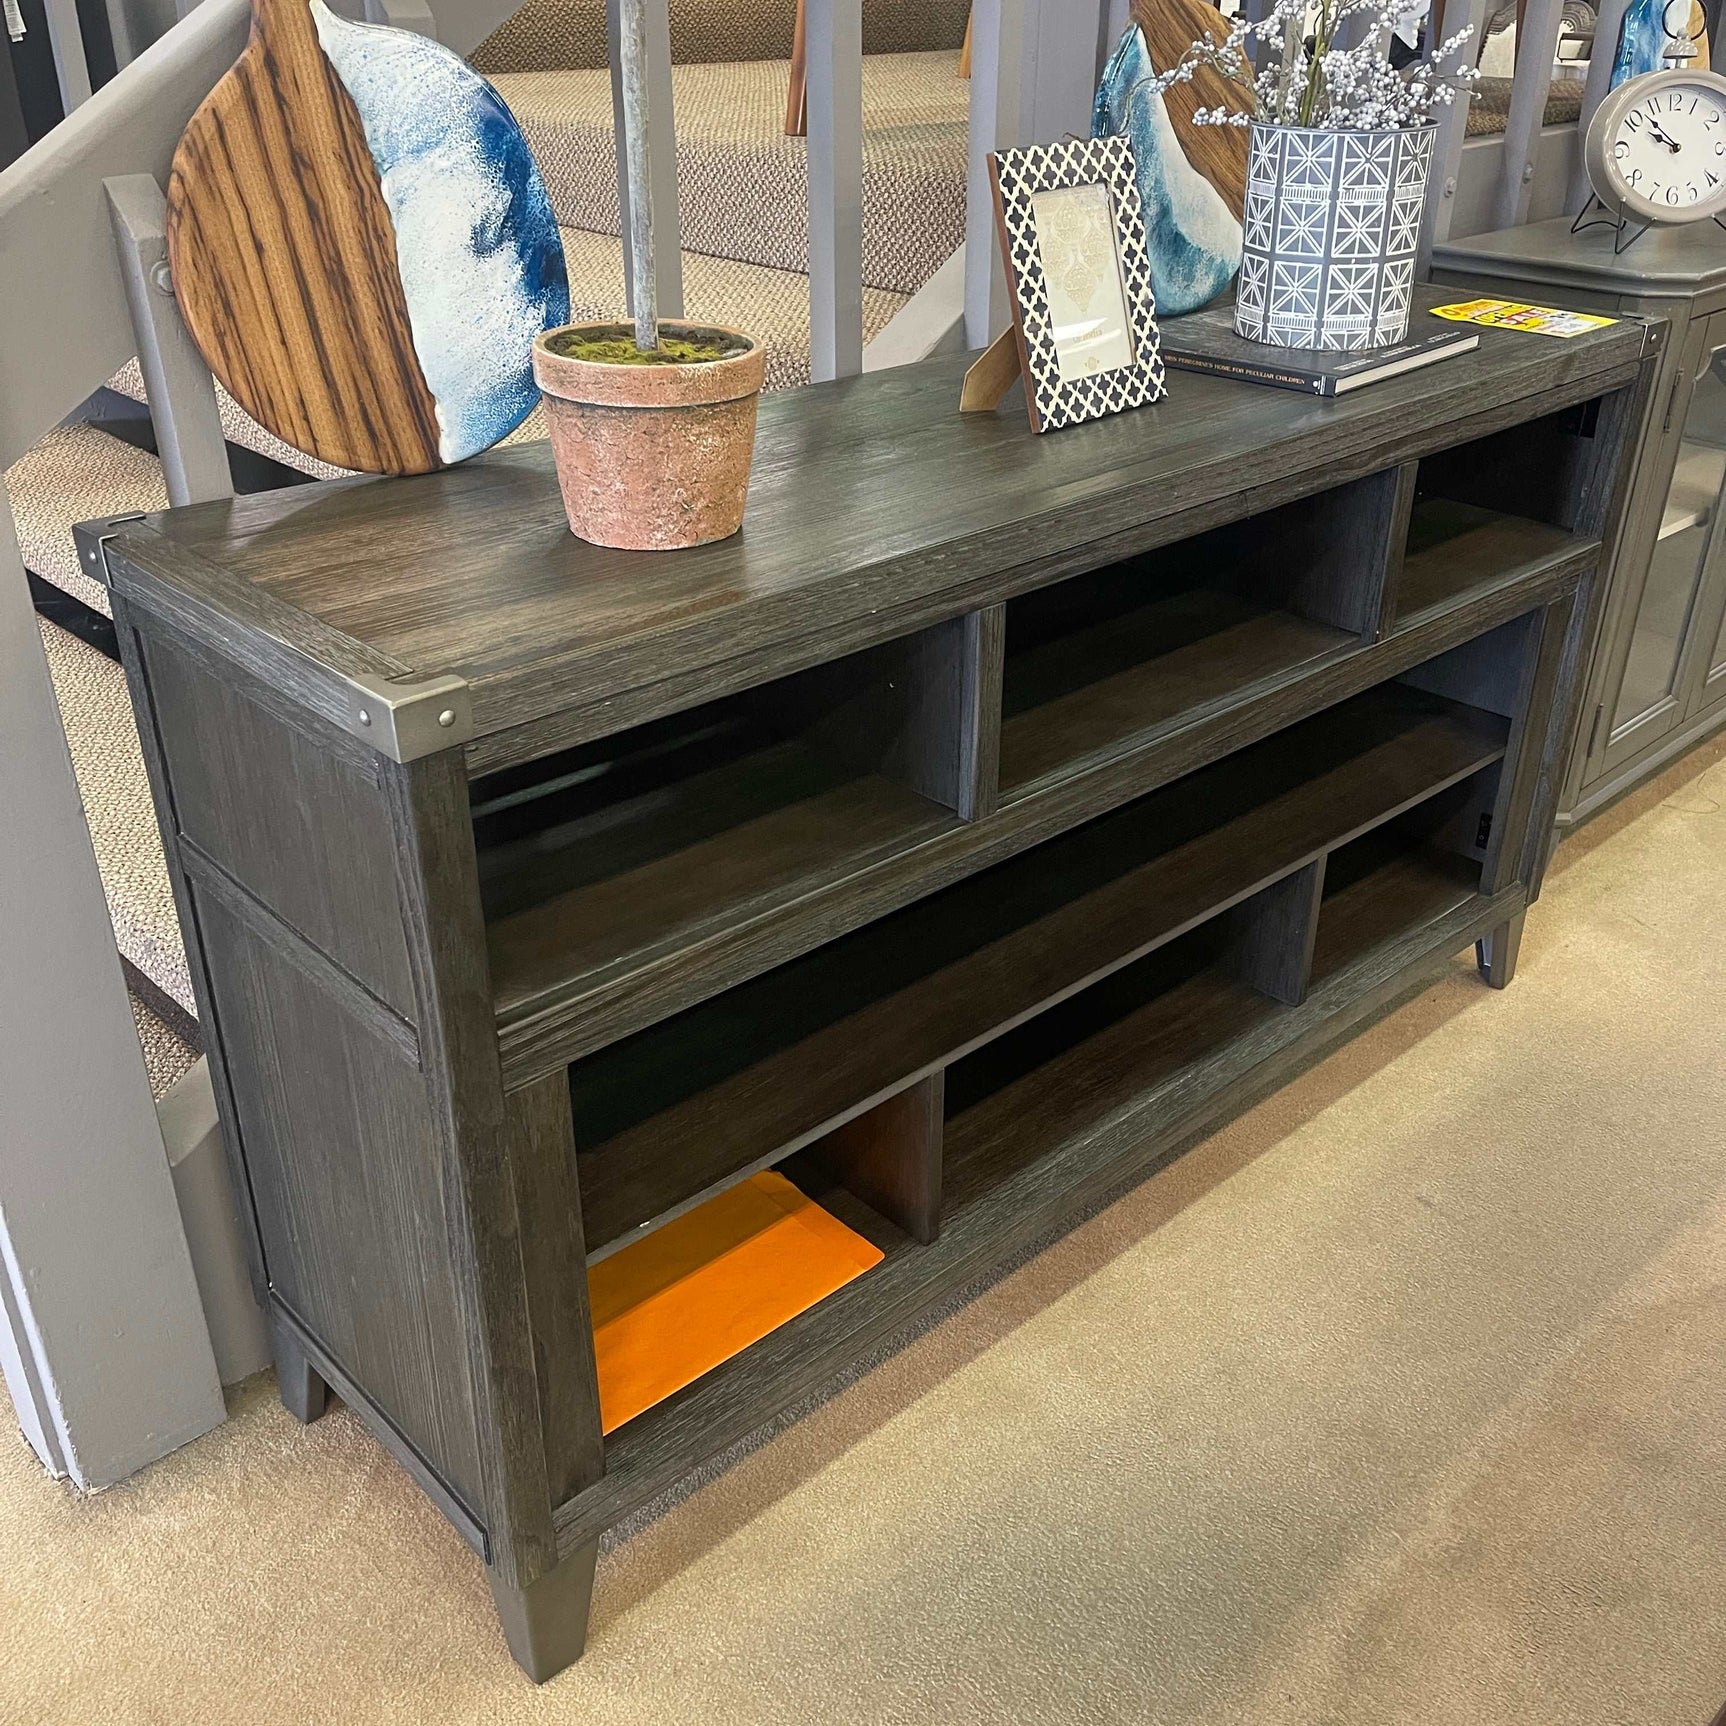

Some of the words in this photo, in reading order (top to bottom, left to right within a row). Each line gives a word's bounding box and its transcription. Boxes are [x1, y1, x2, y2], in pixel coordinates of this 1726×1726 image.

[1647, 97, 1661, 115] 11
[1669, 94, 1682, 111] 12
[1689, 98, 1698, 115] 1
[1624, 110, 1643, 132] 10
[1704, 110, 1719, 131] 2
[1615, 141, 1630, 159] 9
[1626, 168, 1642, 187] 8
[1704, 168, 1719, 187] 4
[1649, 182, 1660, 201] 7
[1666, 186, 1679, 205] 6
[1686, 182, 1698, 201] 5
[1245, 370, 1275, 380] PECULIAR
[1275, 375, 1305, 385] CHILDREN
